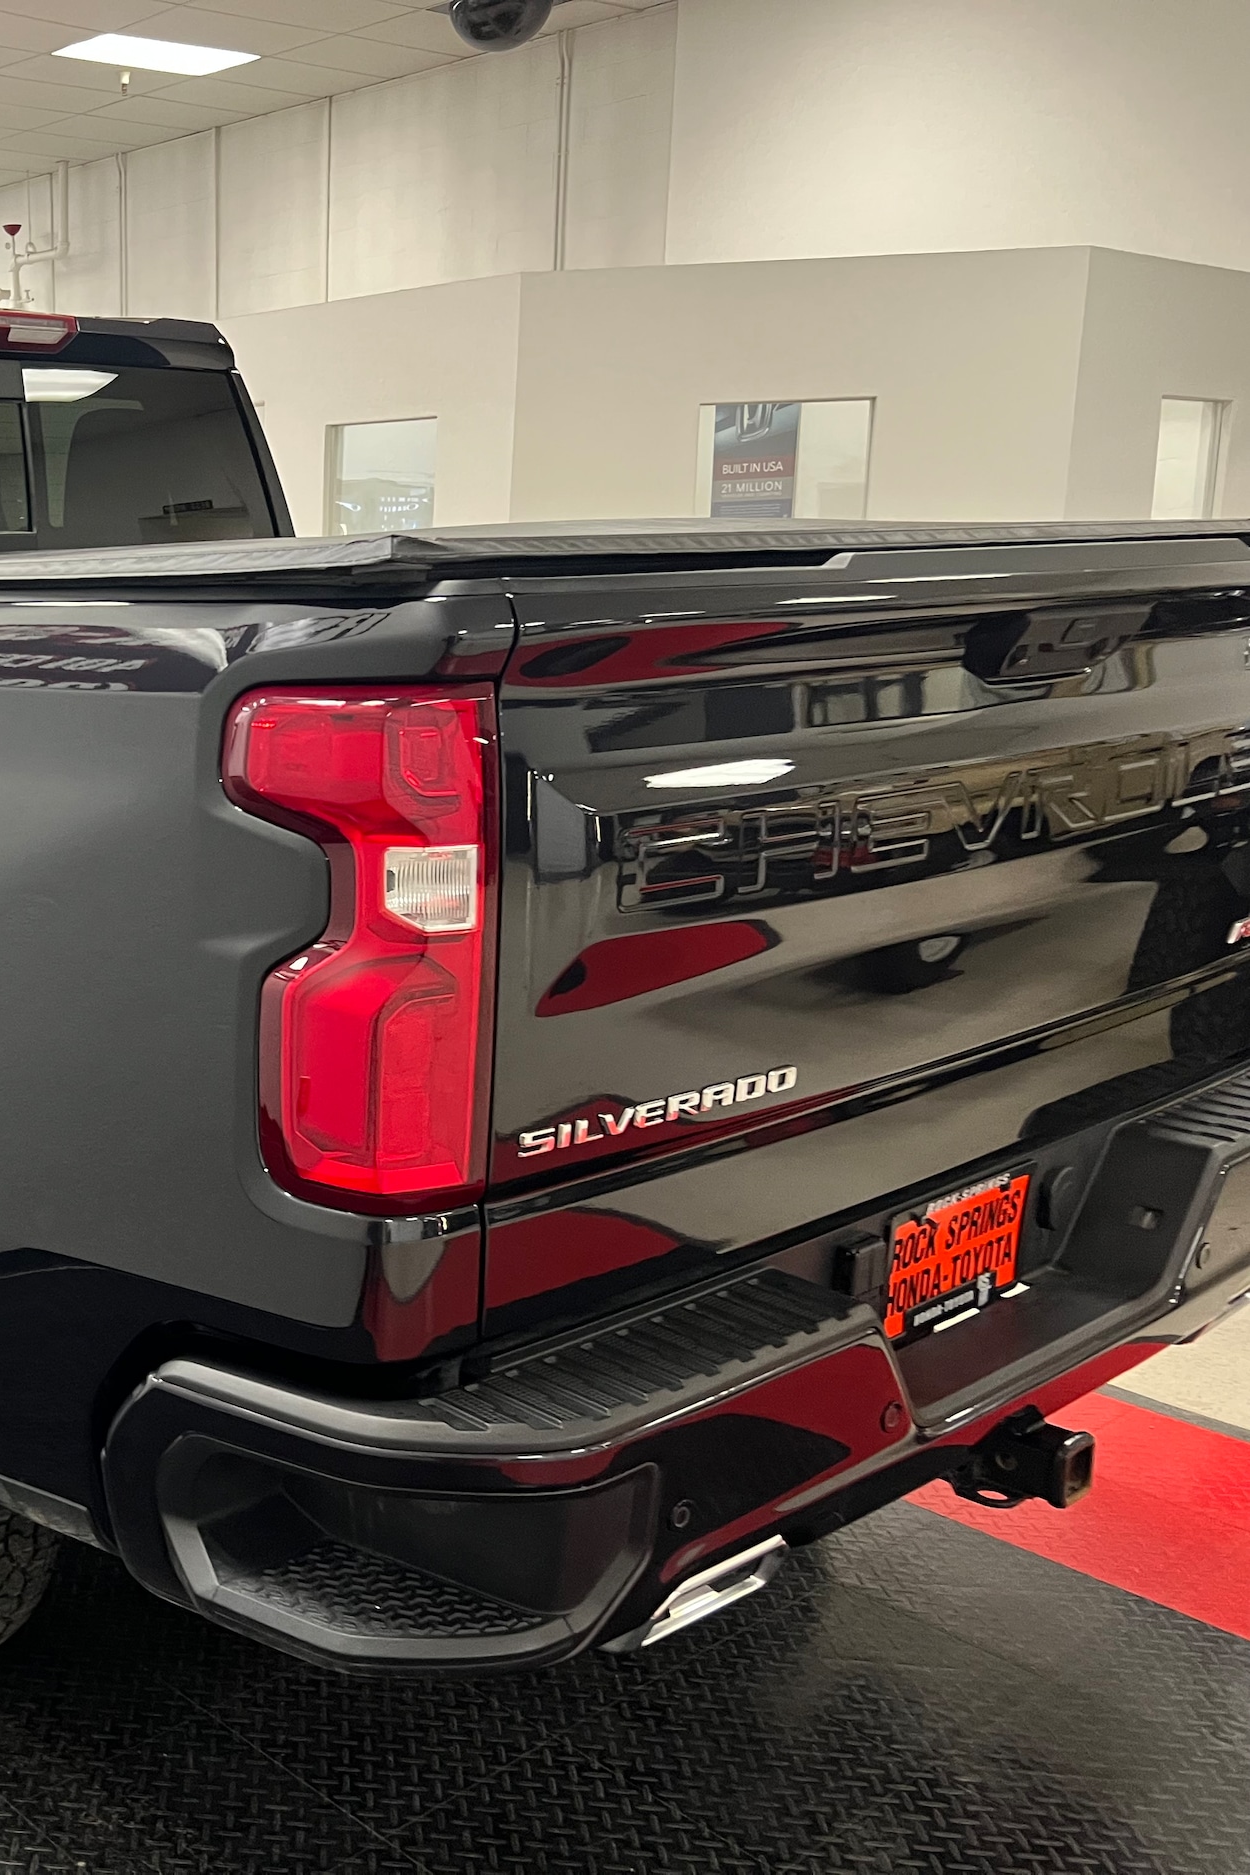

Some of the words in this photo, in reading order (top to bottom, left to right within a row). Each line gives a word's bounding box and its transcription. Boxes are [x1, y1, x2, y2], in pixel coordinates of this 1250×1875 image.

[721, 483, 732, 494] 21
[735, 481, 783, 493] MILLION
[722, 463, 748, 475] BUILT
[750, 462, 761, 473] IN
[763, 461, 783, 472] USA
[517, 1064, 798, 1158] SILVERADO
[891, 1224, 938, 1273] ROCK
[945, 1189, 1021, 1250] SPRINGS
[887, 1232, 1013, 1317] HONDA-TOYOTA
